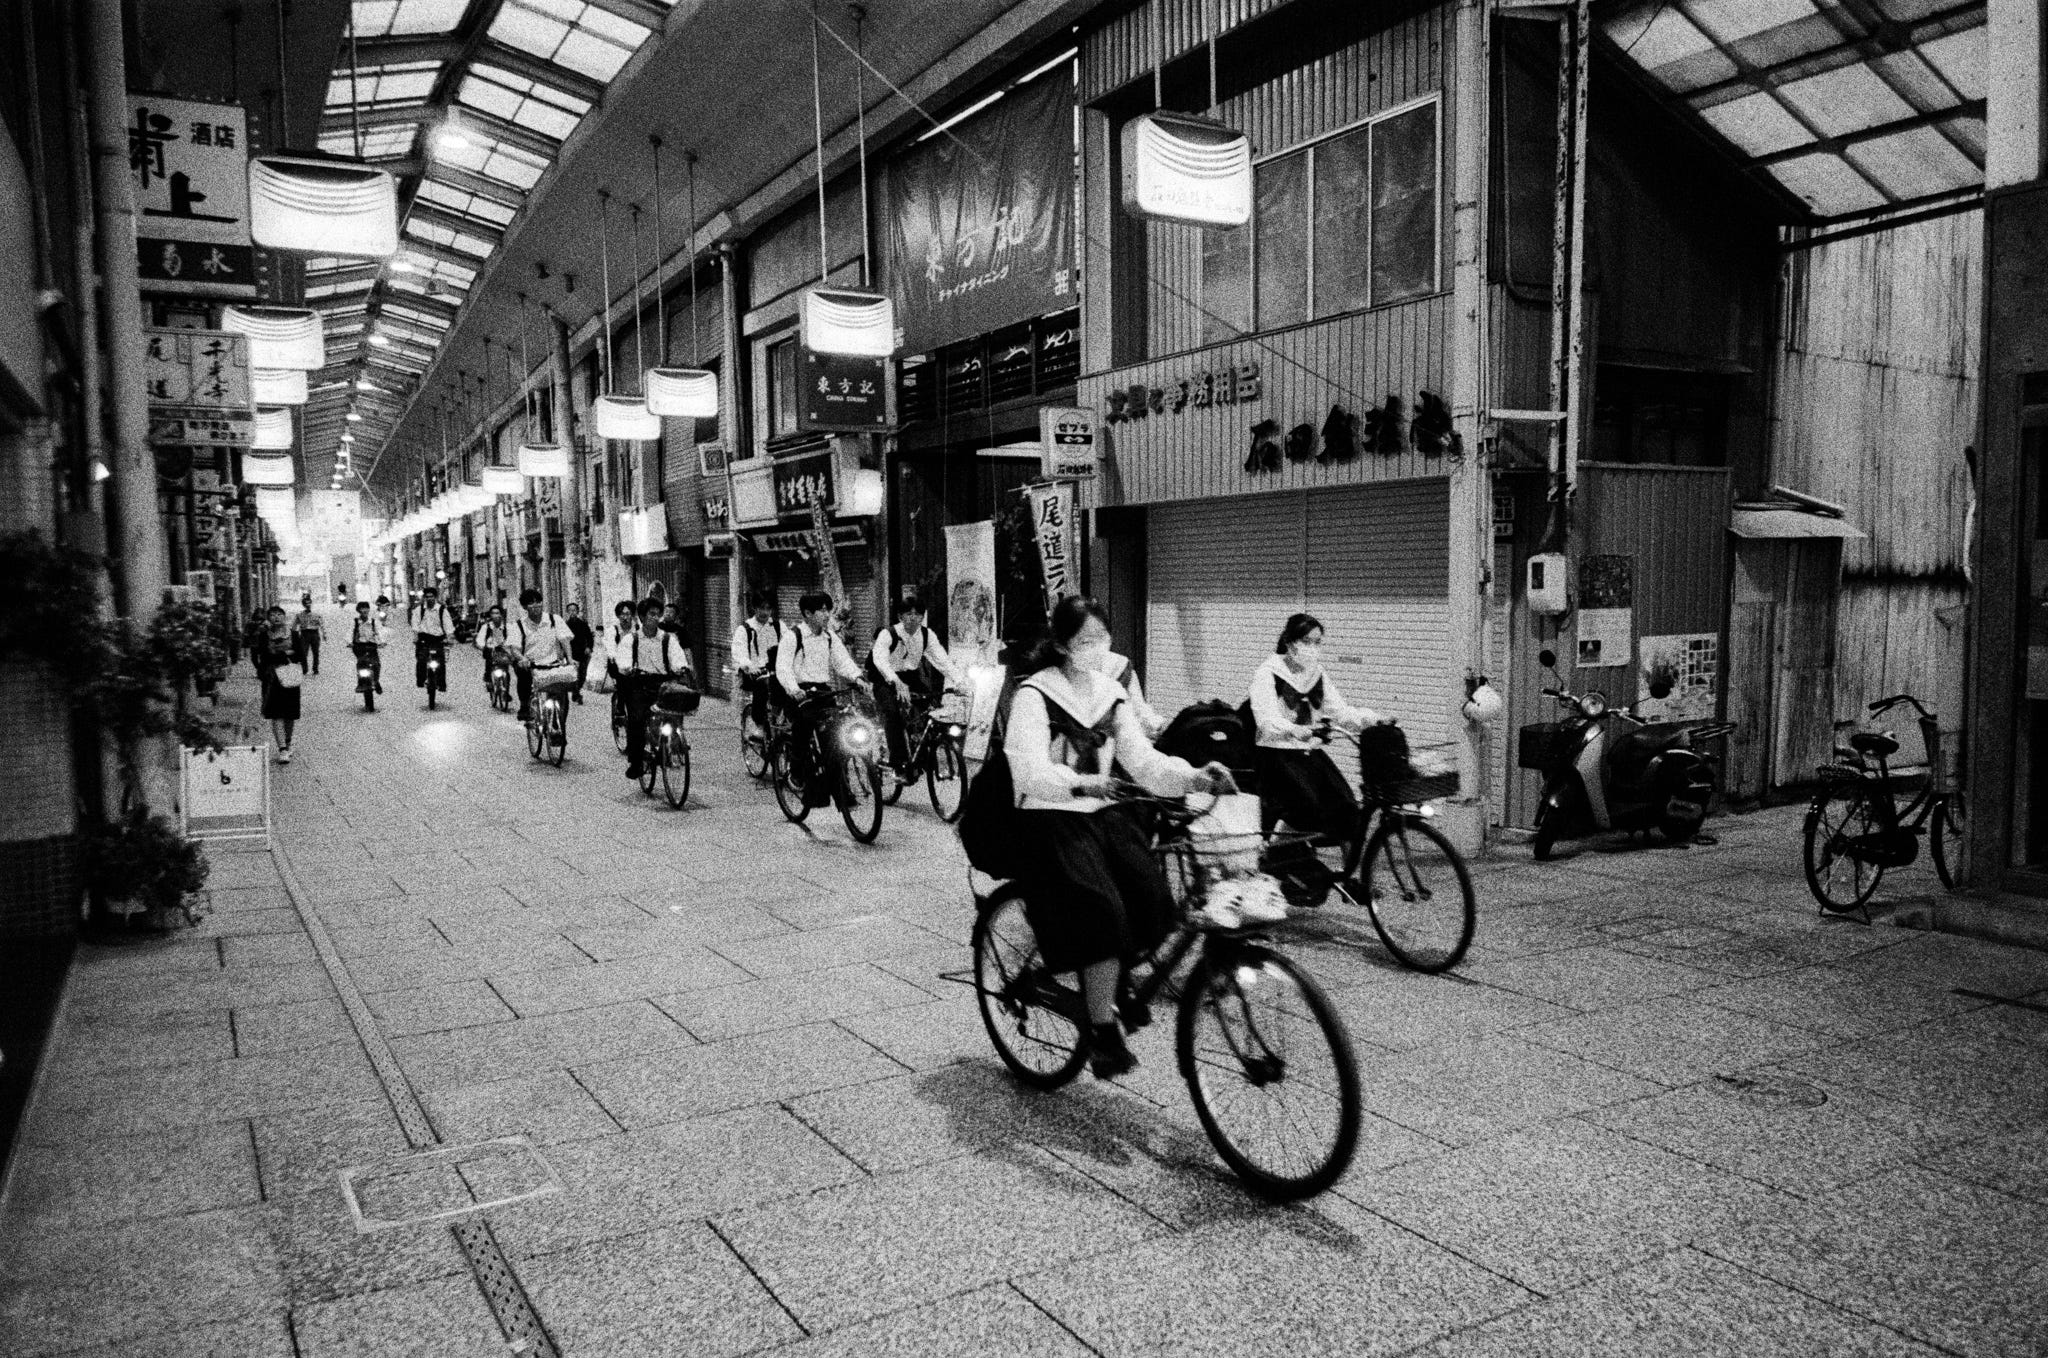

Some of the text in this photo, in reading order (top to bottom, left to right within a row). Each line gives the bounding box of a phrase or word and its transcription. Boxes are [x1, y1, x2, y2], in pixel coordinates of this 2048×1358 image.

[190, 122, 236, 149] 酒店
[817, 376, 876, 394] 東方記
[1039, 495, 1065, 600] 尾道ラ
